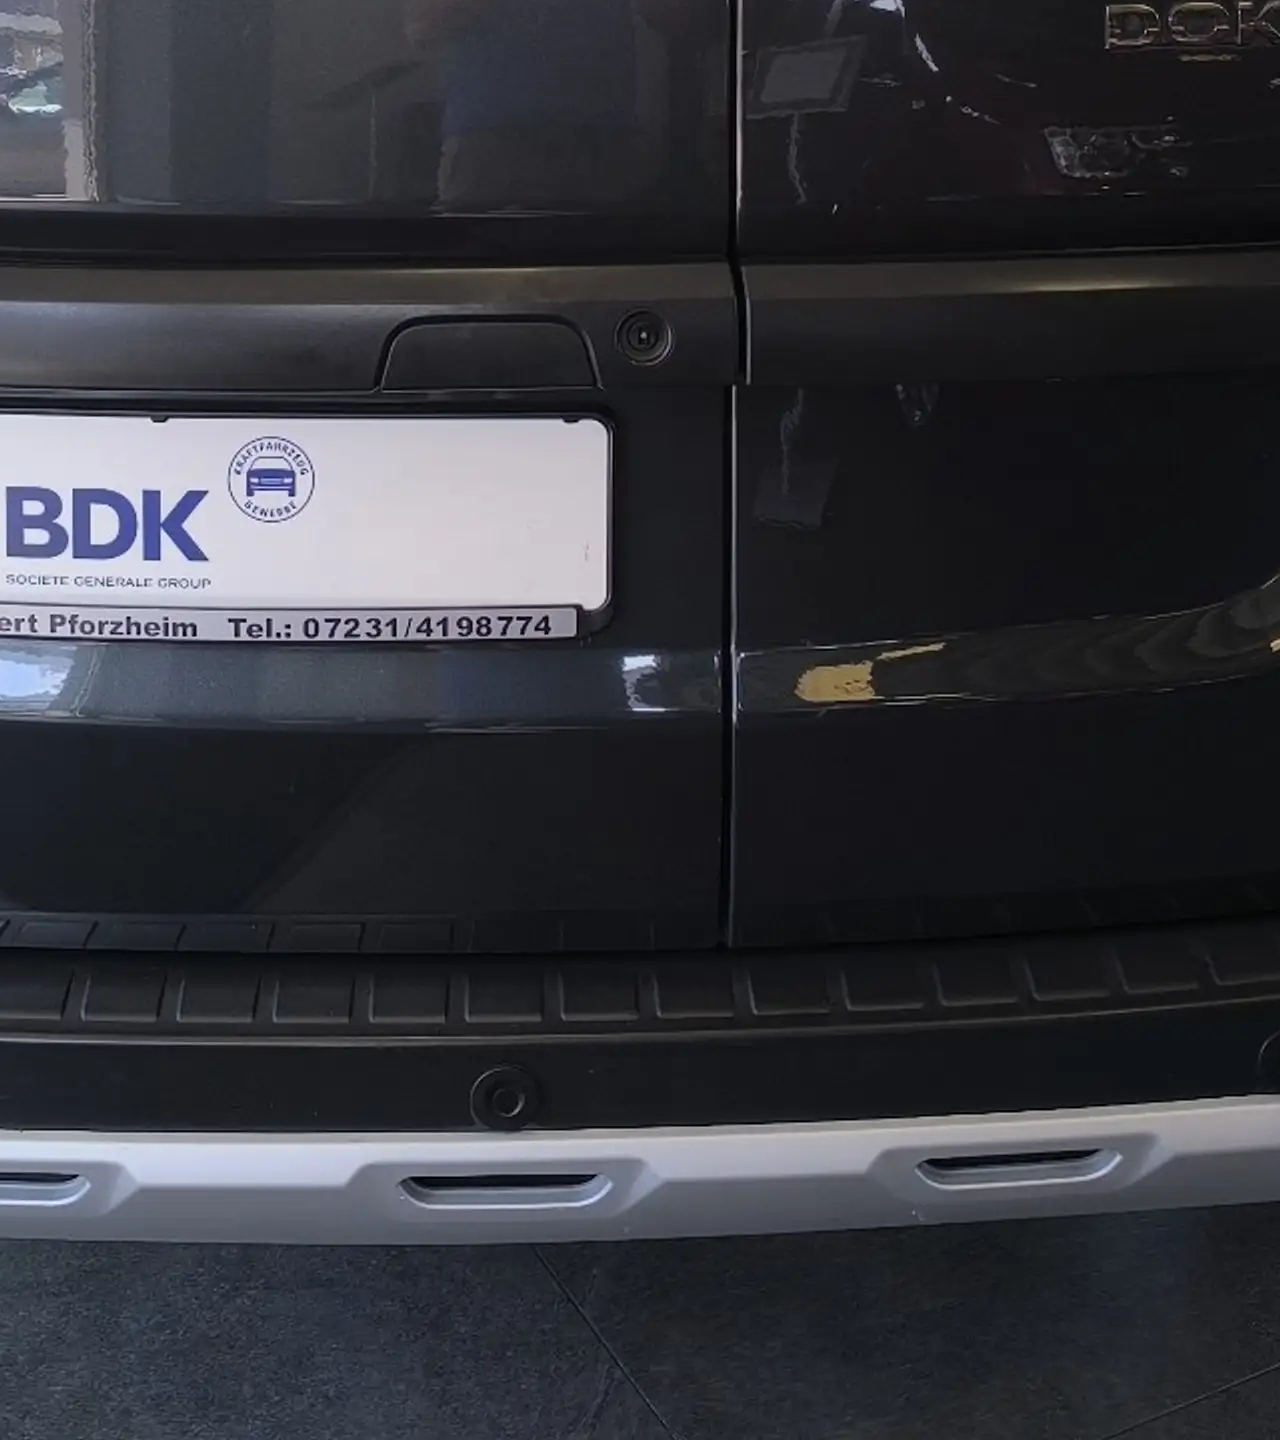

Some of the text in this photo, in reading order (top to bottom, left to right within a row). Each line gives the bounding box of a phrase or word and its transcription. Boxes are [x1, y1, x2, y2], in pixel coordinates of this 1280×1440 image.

[5, 485, 210, 562] BDK
[6, 573, 212, 590] SOCIETE GENERALE GROUP
[49, 616, 199, 639] Pforzheim
[227, 617, 292, 640] Tel.:
[302, 615, 553, 640] 07231/4198774
